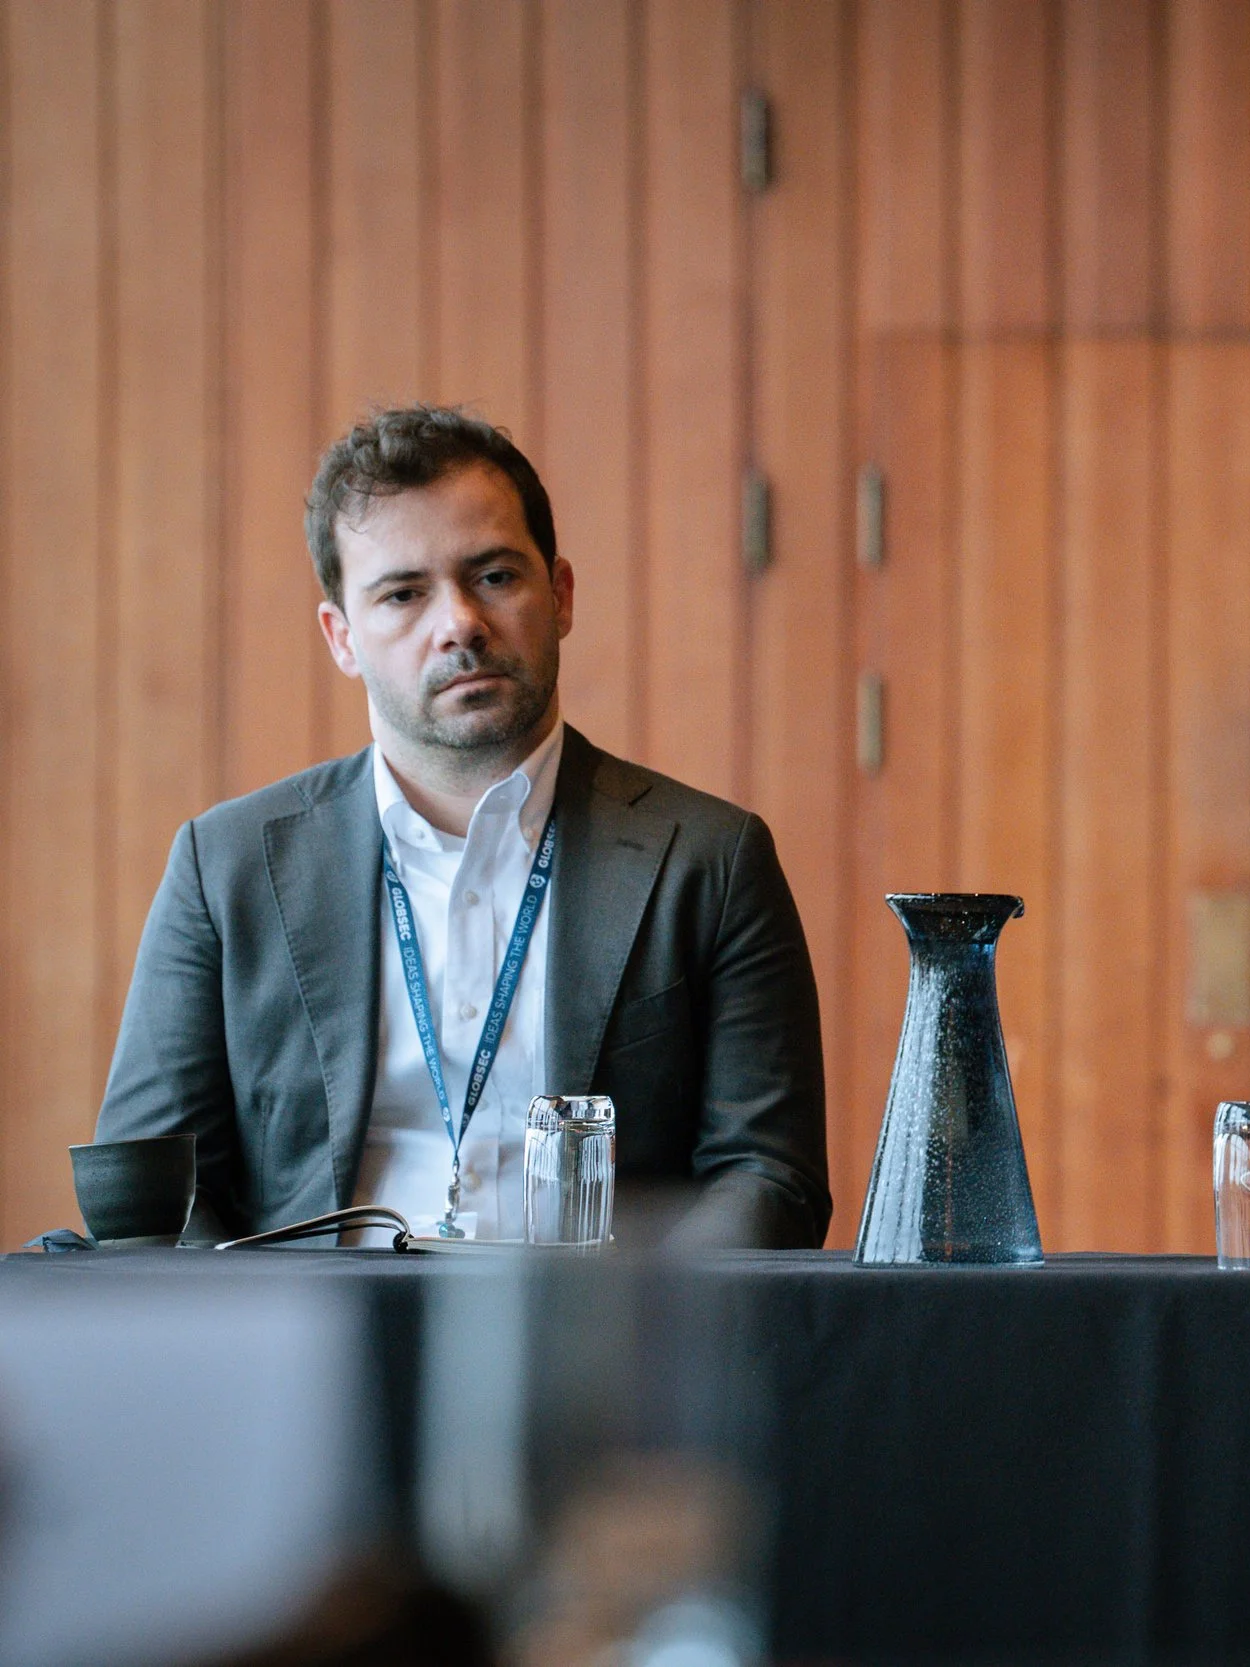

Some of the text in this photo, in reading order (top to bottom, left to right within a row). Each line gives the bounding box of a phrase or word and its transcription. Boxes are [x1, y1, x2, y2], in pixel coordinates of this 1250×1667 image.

[392, 887, 445, 1100] GLOBSEC IDEAS SHAPING THE WORLD
[468, 895, 537, 1106] GLOBSEC IDEAS SHAPING THE WORLD
